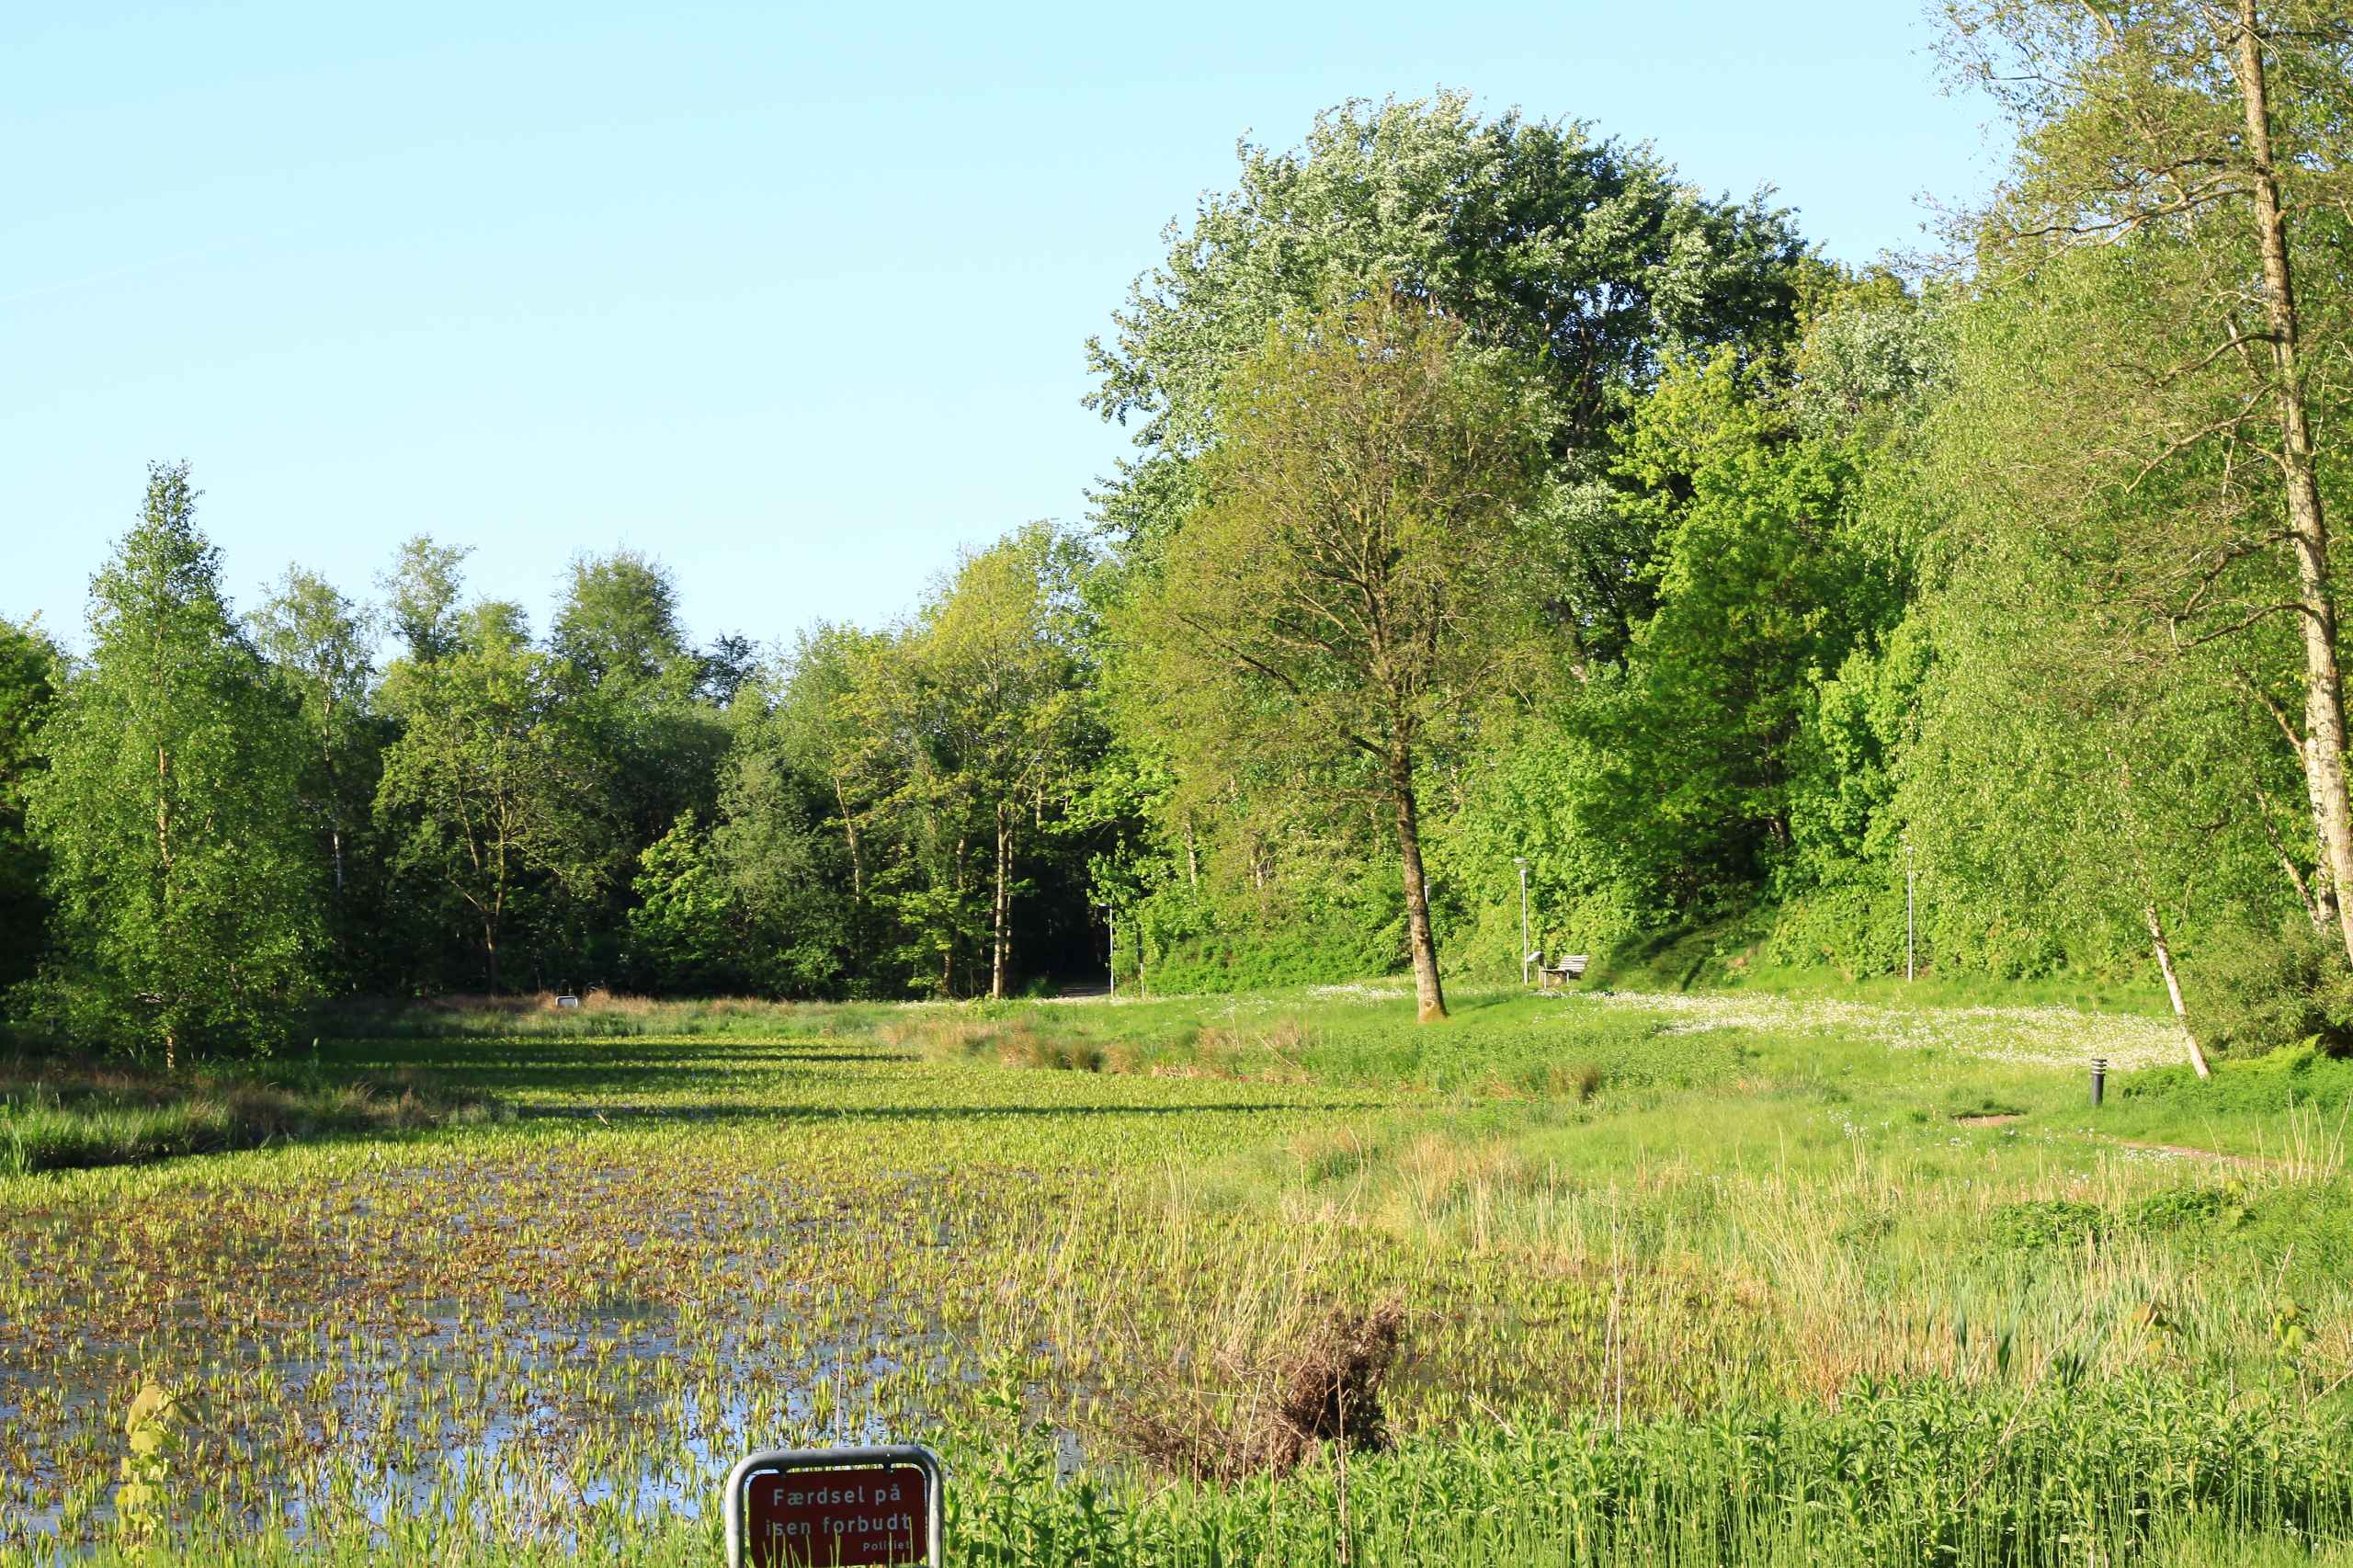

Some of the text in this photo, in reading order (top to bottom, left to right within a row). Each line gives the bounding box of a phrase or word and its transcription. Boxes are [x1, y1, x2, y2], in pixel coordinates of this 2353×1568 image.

[773, 1483, 902, 1506] Færdsel på
[765, 1513, 911, 1537] isen forbudt
[862, 1540, 910, 1552] Poliiet
